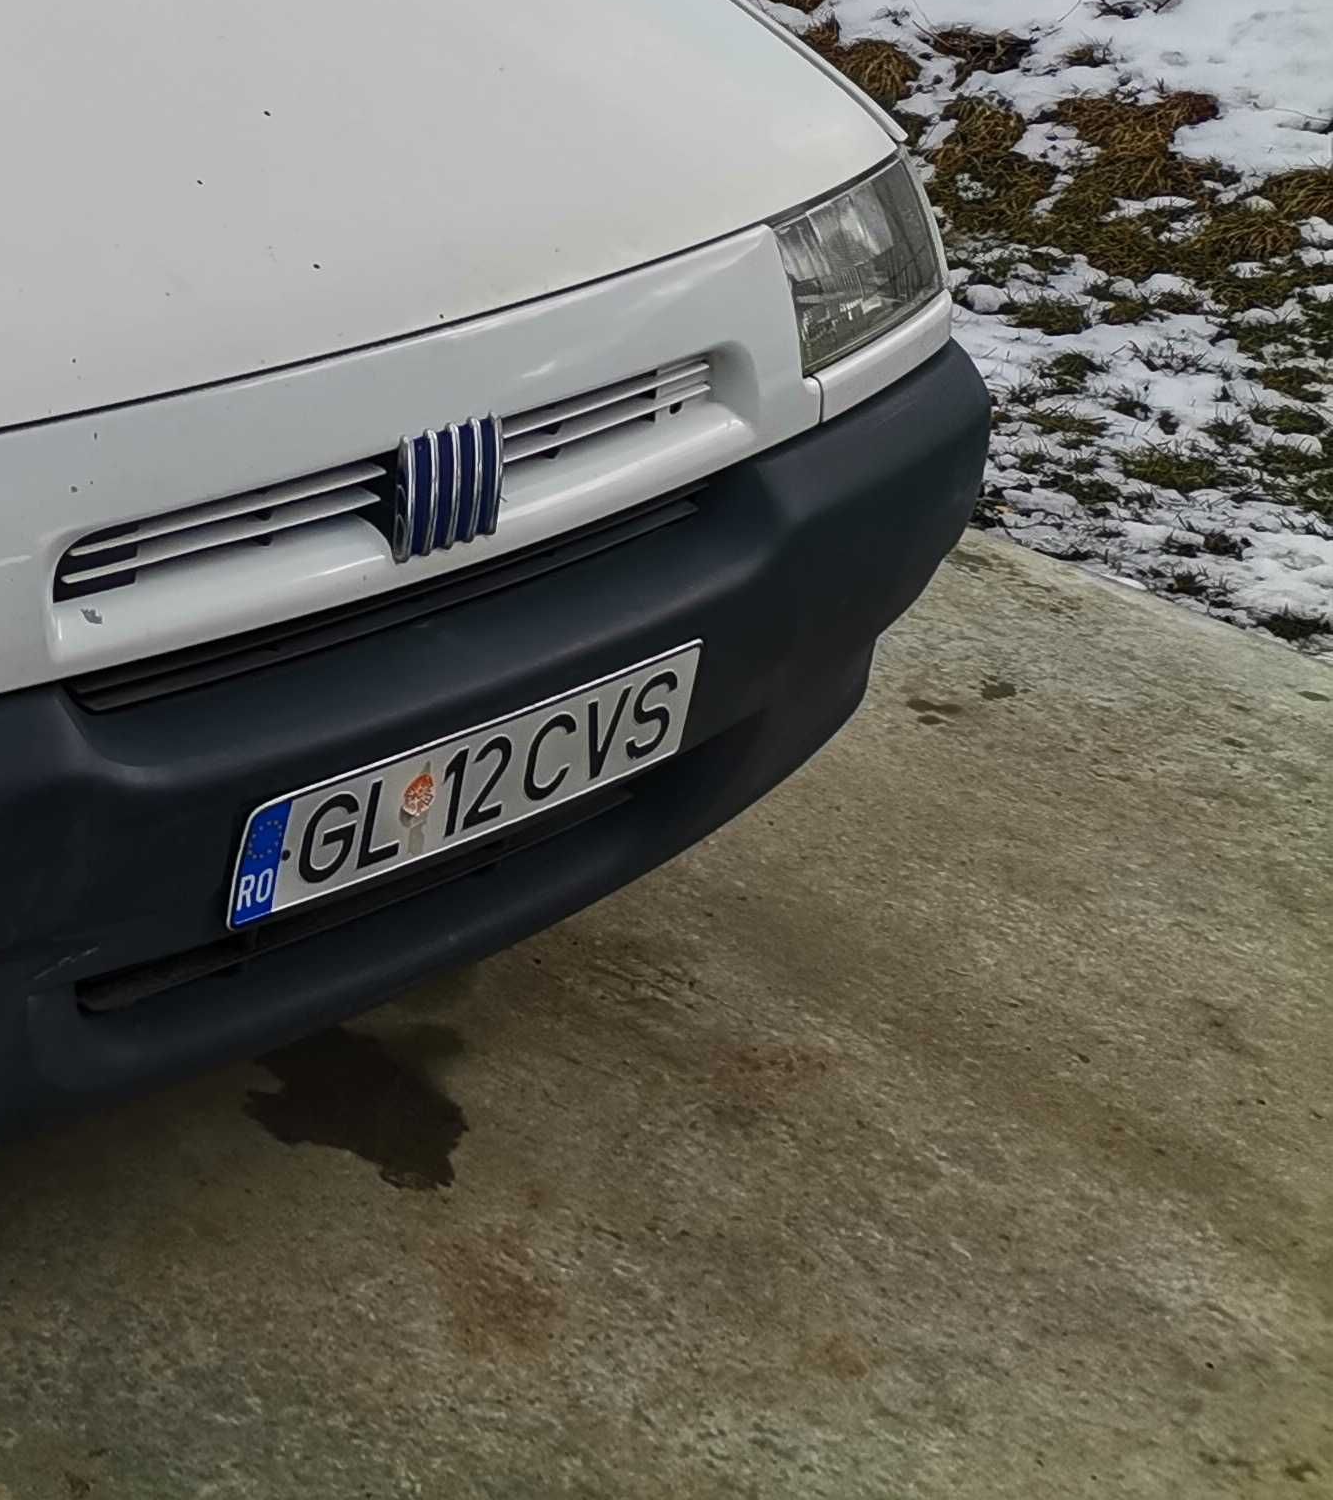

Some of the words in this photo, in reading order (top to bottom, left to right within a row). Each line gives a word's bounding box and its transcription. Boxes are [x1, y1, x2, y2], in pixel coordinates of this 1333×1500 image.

[298, 781, 400, 884] GL
[443, 735, 513, 838] 12
[523, 668, 679, 801] CVS
[235, 866, 274, 912] RO
